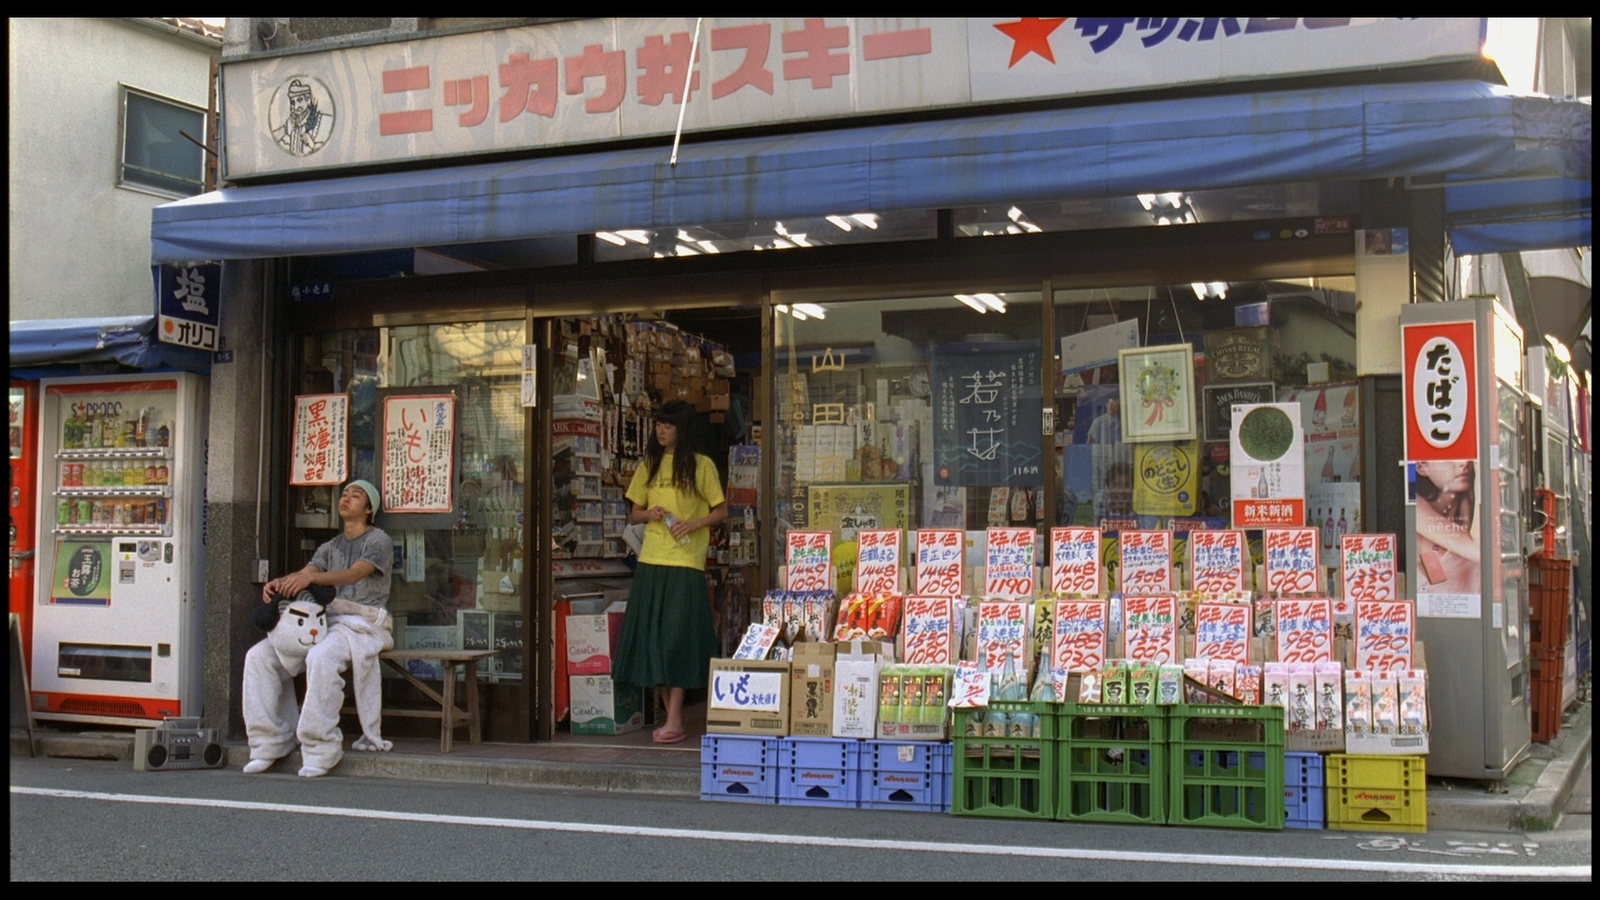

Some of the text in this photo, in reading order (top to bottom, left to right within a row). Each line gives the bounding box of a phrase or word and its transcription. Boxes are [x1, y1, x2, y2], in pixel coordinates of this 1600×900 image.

[173, 268, 209, 316] 塩
[177, 322, 216, 349] オリコ
[1426, 344, 1460, 442] たばこ
[1013, 466, 1039, 475] 日本酒
[1144, 455, 1188, 477] のどごし
[1244, 504, 1293, 518] 新米新酒
[790, 534, 826, 549] 特価
[861, 533, 896, 546] 特価
[920, 533, 957, 547] 特価
[989, 531, 1031, 547] 特価
[1054, 531, 1095, 545] 特価
[1123, 534, 1164, 548] 特価
[1195, 534, 1237, 548] 特価
[1268, 532, 1312, 549] 特価
[1345, 538, 1389, 552] 特価
[790, 576, 826, 591] 1090
[920, 576, 960, 594] 1090
[1055, 576, 1095, 593] 1090
[1271, 570, 1315, 593] 980
[906, 600, 947, 618] 特価
[981, 604, 1022, 620] 特価
[1059, 604, 1102, 620] 特価
[1127, 598, 1171, 615] 特価
[1280, 602, 1326, 621] 特価
[1360, 604, 1406, 623] 特価
[1200, 607, 1245, 625] 特価
[1285, 631, 1328, 651] 980
[1060, 649, 1101, 669] 930
